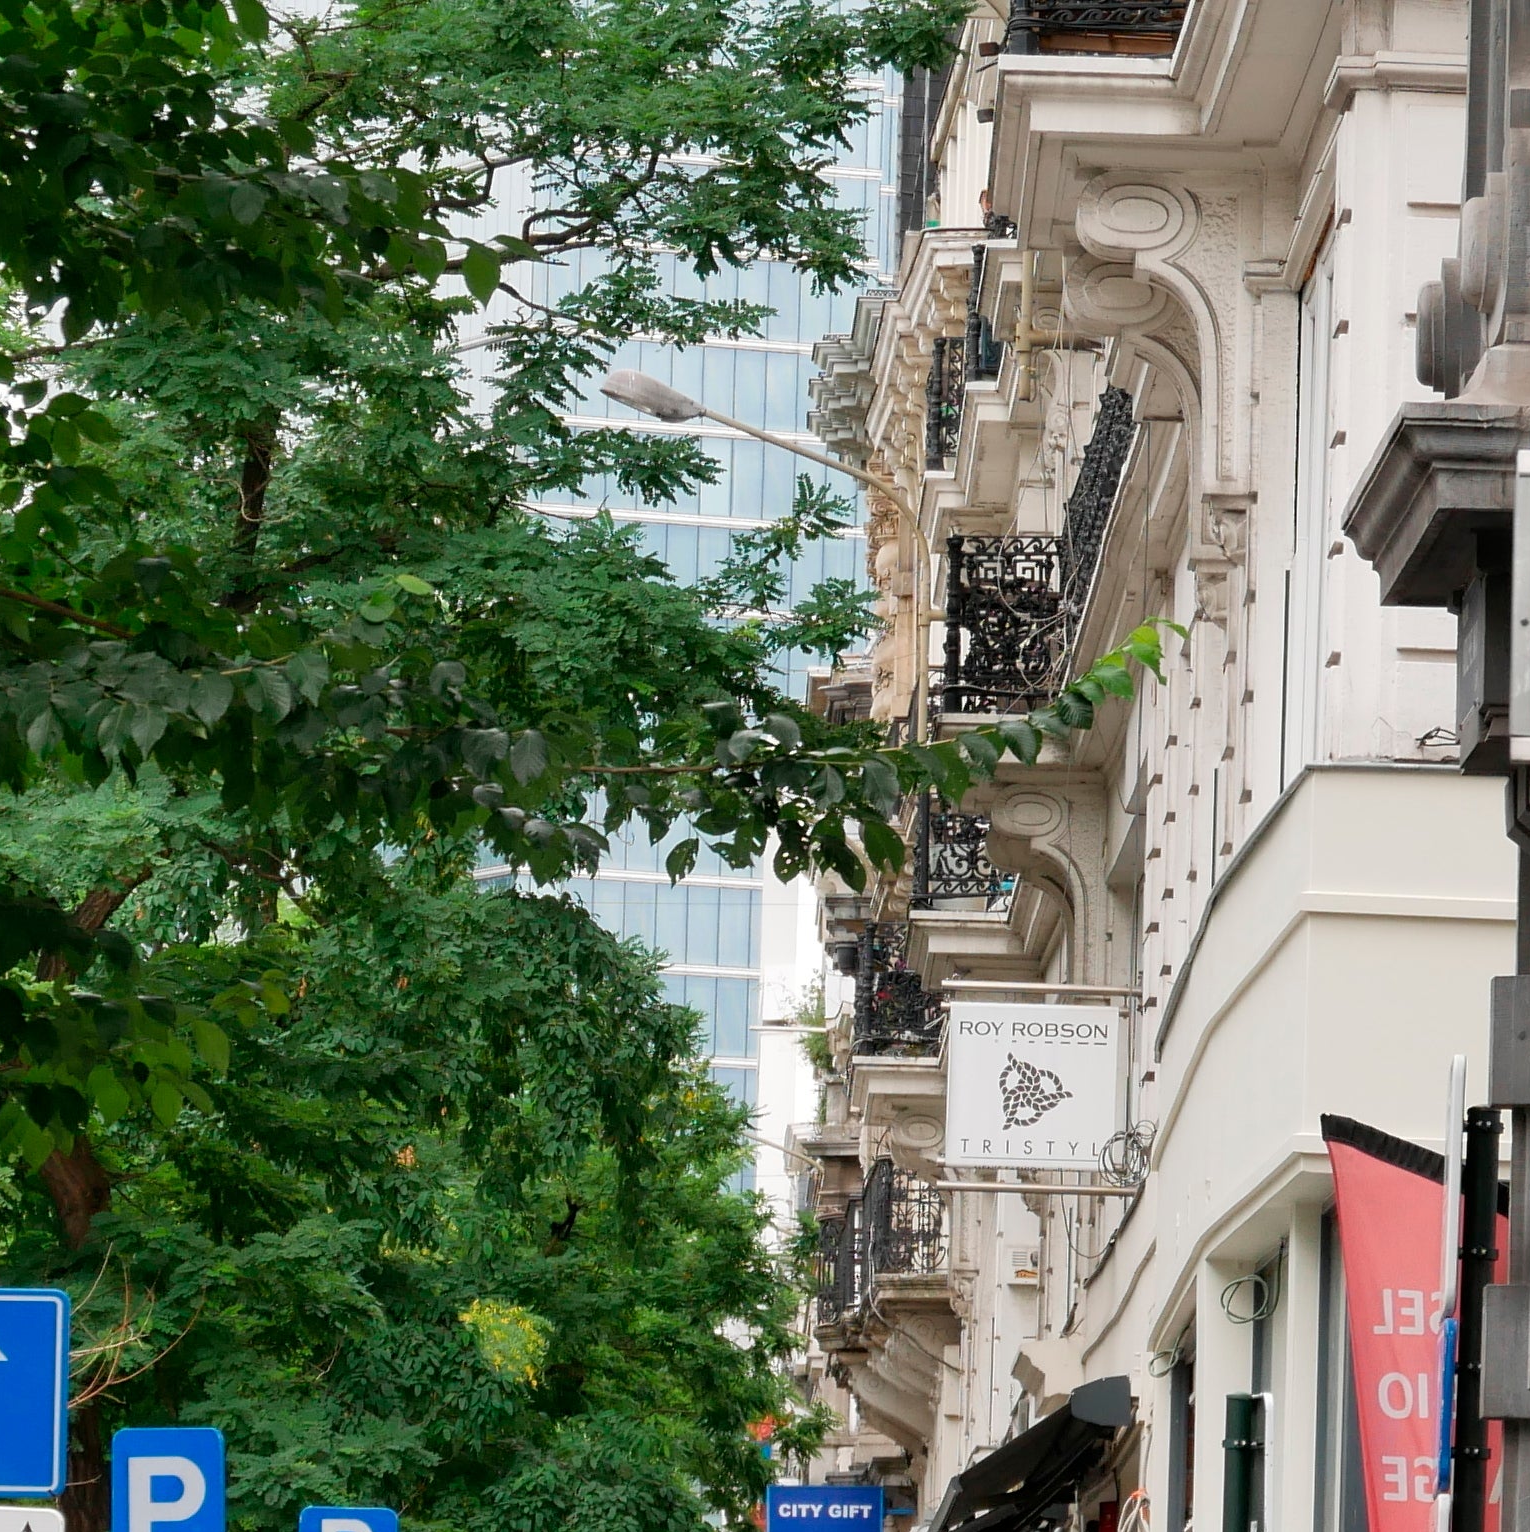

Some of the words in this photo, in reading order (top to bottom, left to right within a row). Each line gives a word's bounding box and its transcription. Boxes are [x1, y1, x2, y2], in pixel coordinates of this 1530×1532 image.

[959, 1020, 1004, 1036] ROY
[1012, 1022, 1109, 1039] ROBSON
[778, 1504, 822, 1518] CITY
[829, 1504, 872, 1519] GIFT
